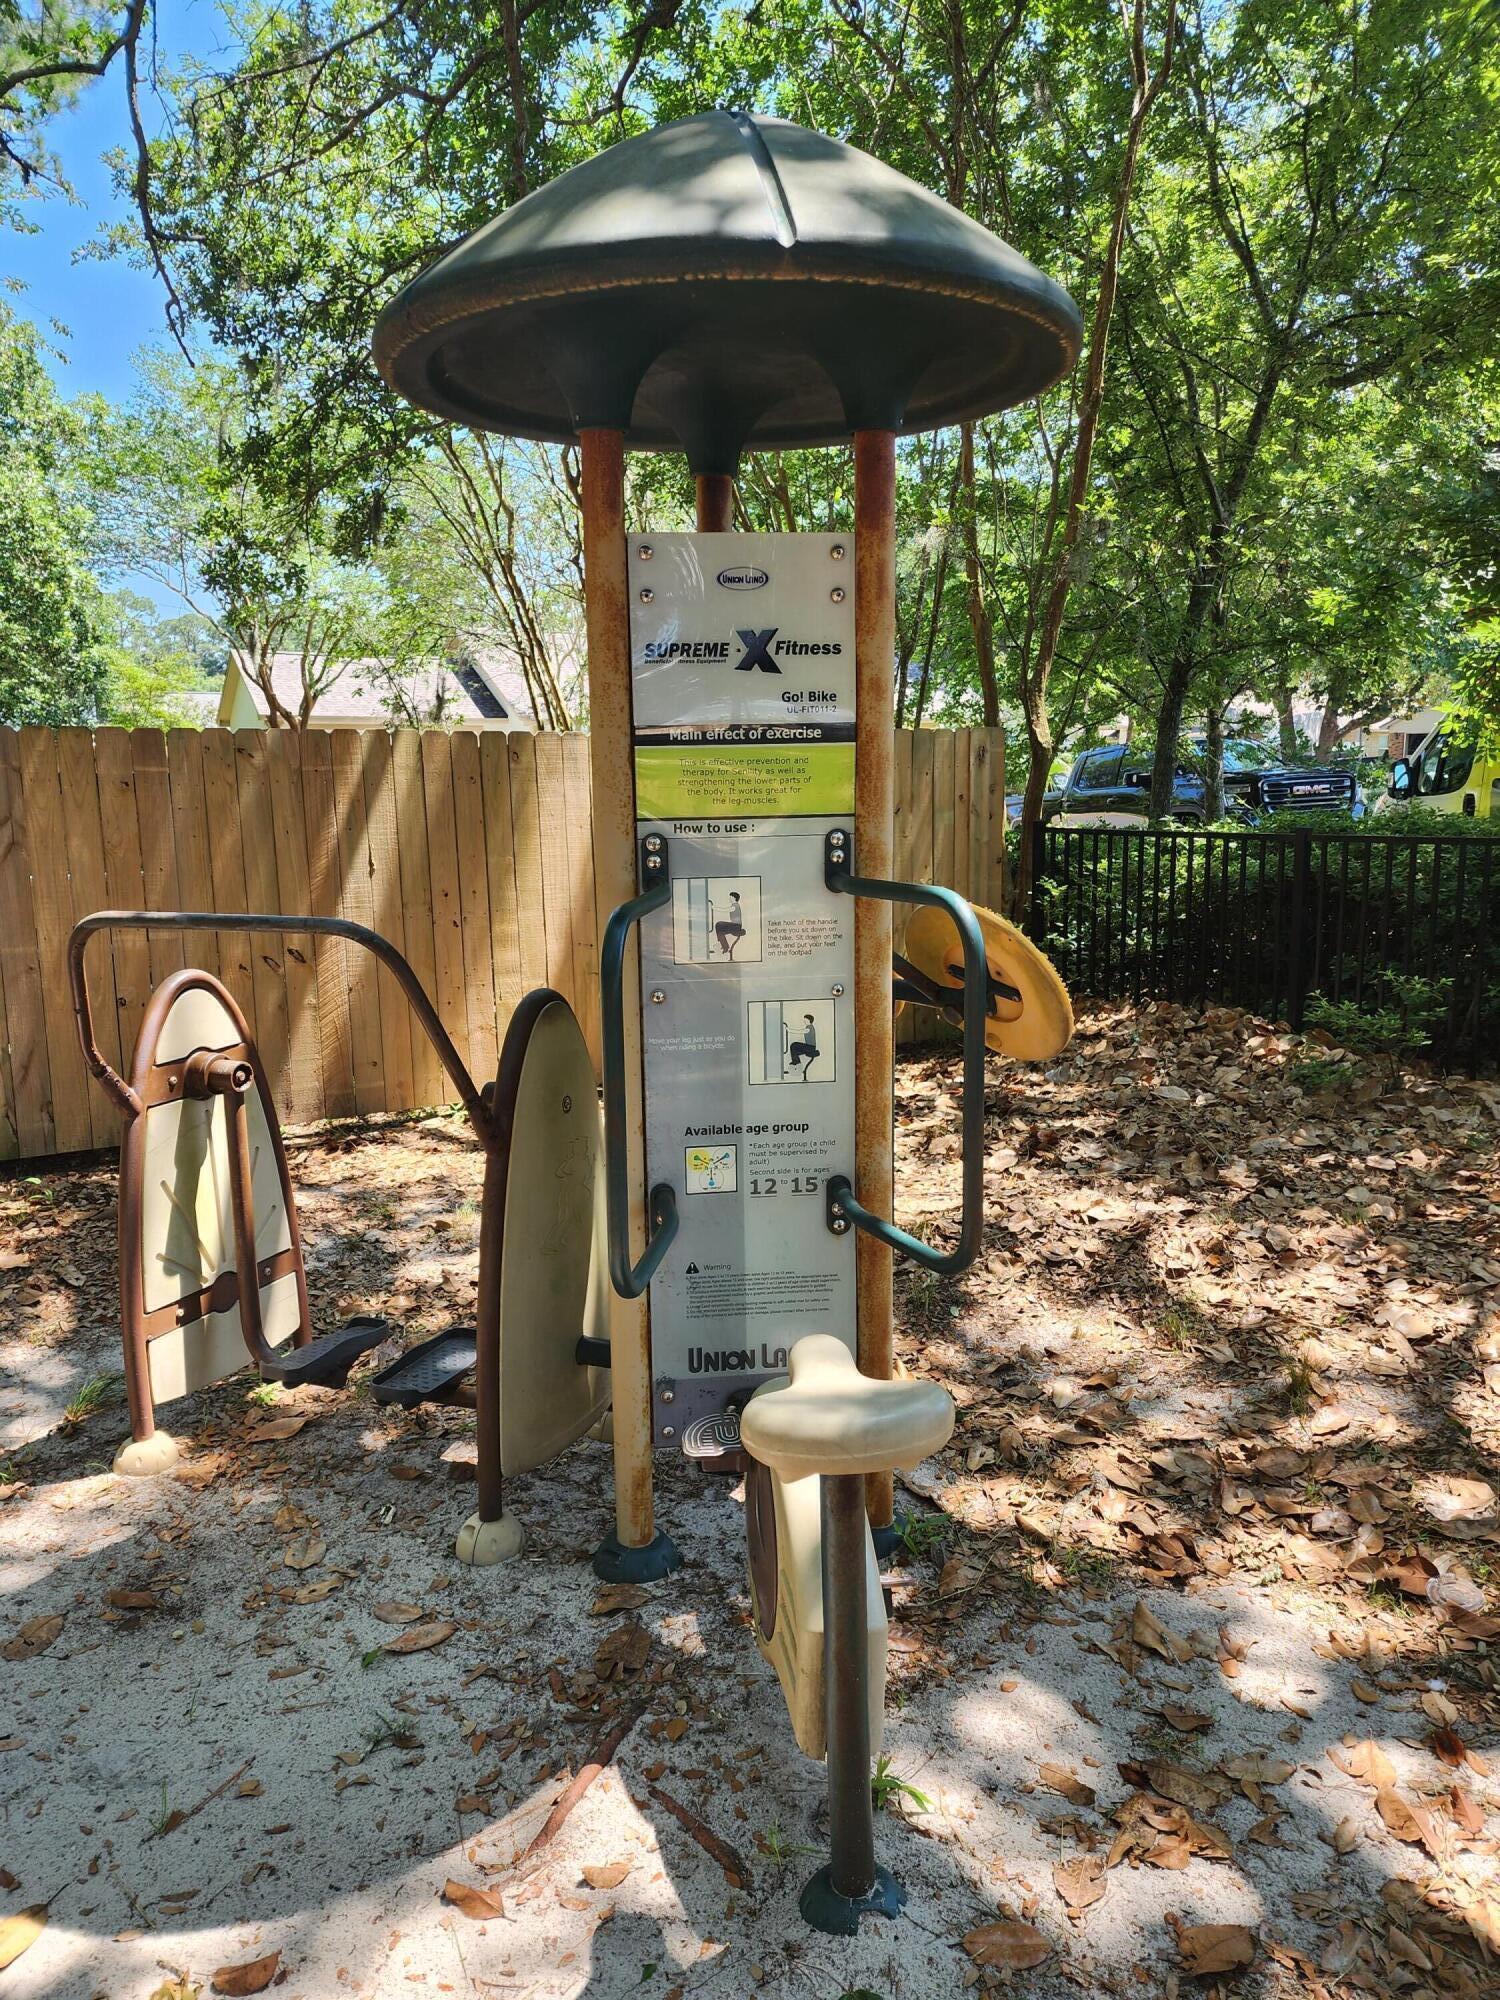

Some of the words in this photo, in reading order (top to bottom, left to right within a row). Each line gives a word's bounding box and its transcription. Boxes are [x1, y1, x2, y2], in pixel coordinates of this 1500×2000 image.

[644, 642, 730, 658] SUPREME
[734, 628, 782, 674] X
[774, 640, 842, 655] Fitness
[781, 691, 803, 702] Go!
[808, 691, 837, 702] Bike
[786, 705, 837, 714] UL-FIT011-2
[669, 729, 702, 741] Main
[706, 728, 745, 740] effect
[749, 728, 762, 739] of
[766, 726, 822, 739] exercise
[679, 758, 697, 766] This
[700, 758, 706, 766] is
[708, 757, 744, 766] effective
[746, 757, 791, 767] prevention
[682, 768, 714, 778] therapy
[677, 778, 735, 787] strengthening
[779, 777, 801, 785] parts
[765, 787, 787, 795] great
[1292, 784, 1331, 795] GMC
[712, 797, 726, 805] the
[673, 823, 703, 834] How
[706, 823, 720, 833] to
[724, 823, 747, 833] use
[685, 1124, 743, 1137] Available
[746, 1124, 769, 1135] age
[772, 1123, 810, 1135] group
[810, 1139, 818, 1148] (a
[749, 1150, 767, 1158] must
[769, 1149, 778, 1157] be
[779, 1148, 819, 1157] supervised
[819, 1148, 828, 1156] by
[749, 1158, 770, 1166] adult)
[749, 1168, 775, 1176] Second
[777, 1167, 791, 1175] side
[801, 1166, 812, 1174] for
[750, 1177, 778, 1195] 12
[791, 1176, 818, 1194] 15
[703, 1263, 731, 1271] Warning
[688, 1347, 756, 1374] UNION
[761, 1343, 788, 1369] LA
